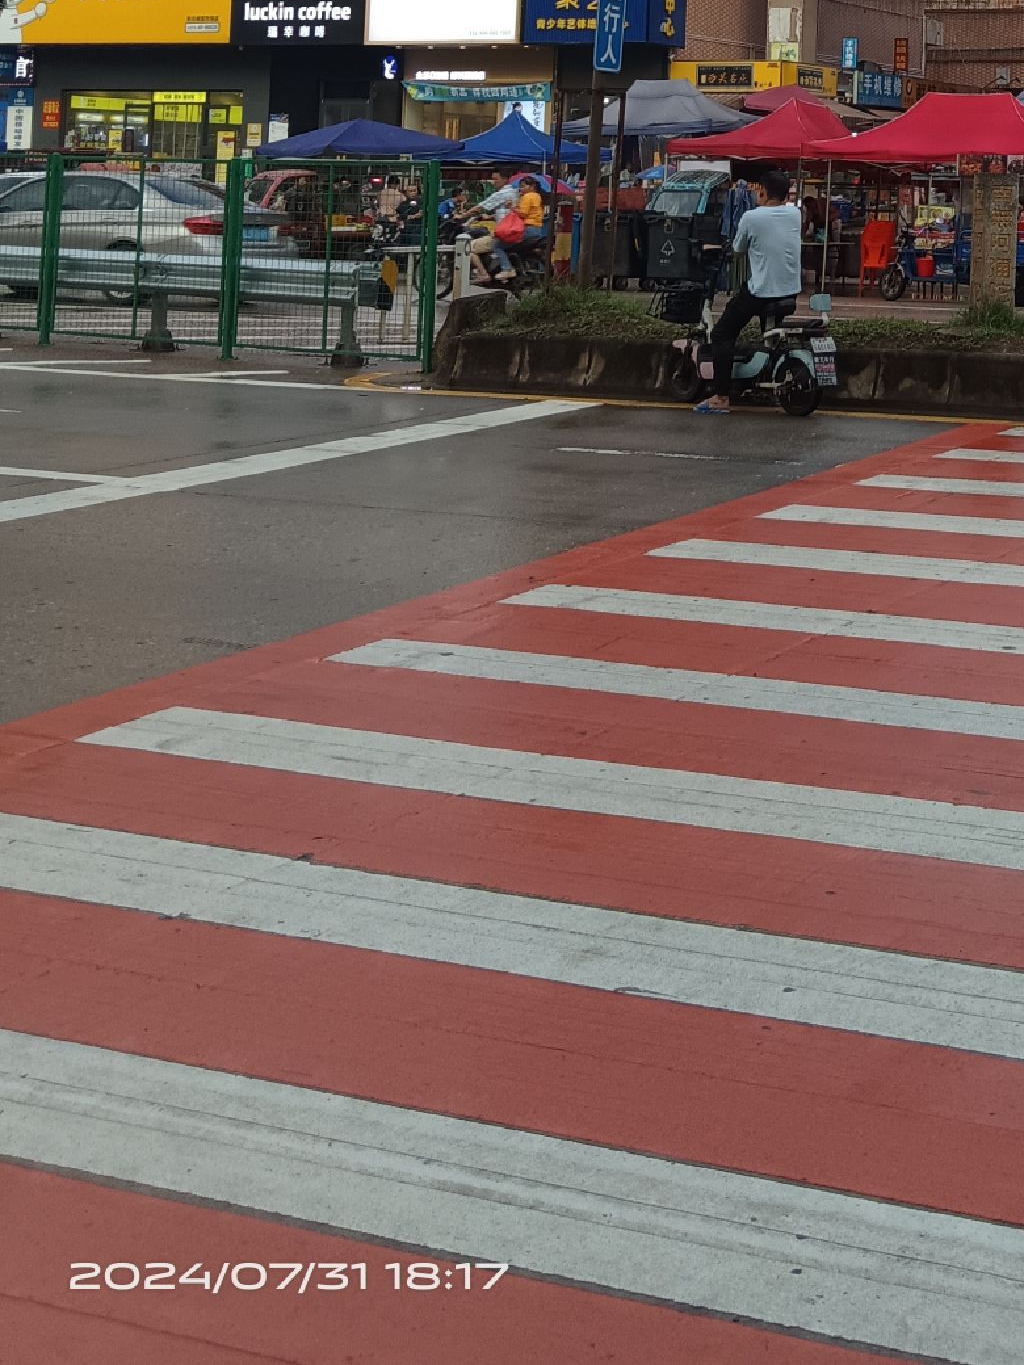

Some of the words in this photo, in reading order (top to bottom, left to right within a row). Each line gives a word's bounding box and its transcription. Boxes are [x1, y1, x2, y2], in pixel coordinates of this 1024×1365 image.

[244, 1, 294, 21] luckin
[298, 0, 352, 21] coffee
[267, 25, 325, 39] 瑞幸咖啡
[863, 74, 902, 97] 手机维修
